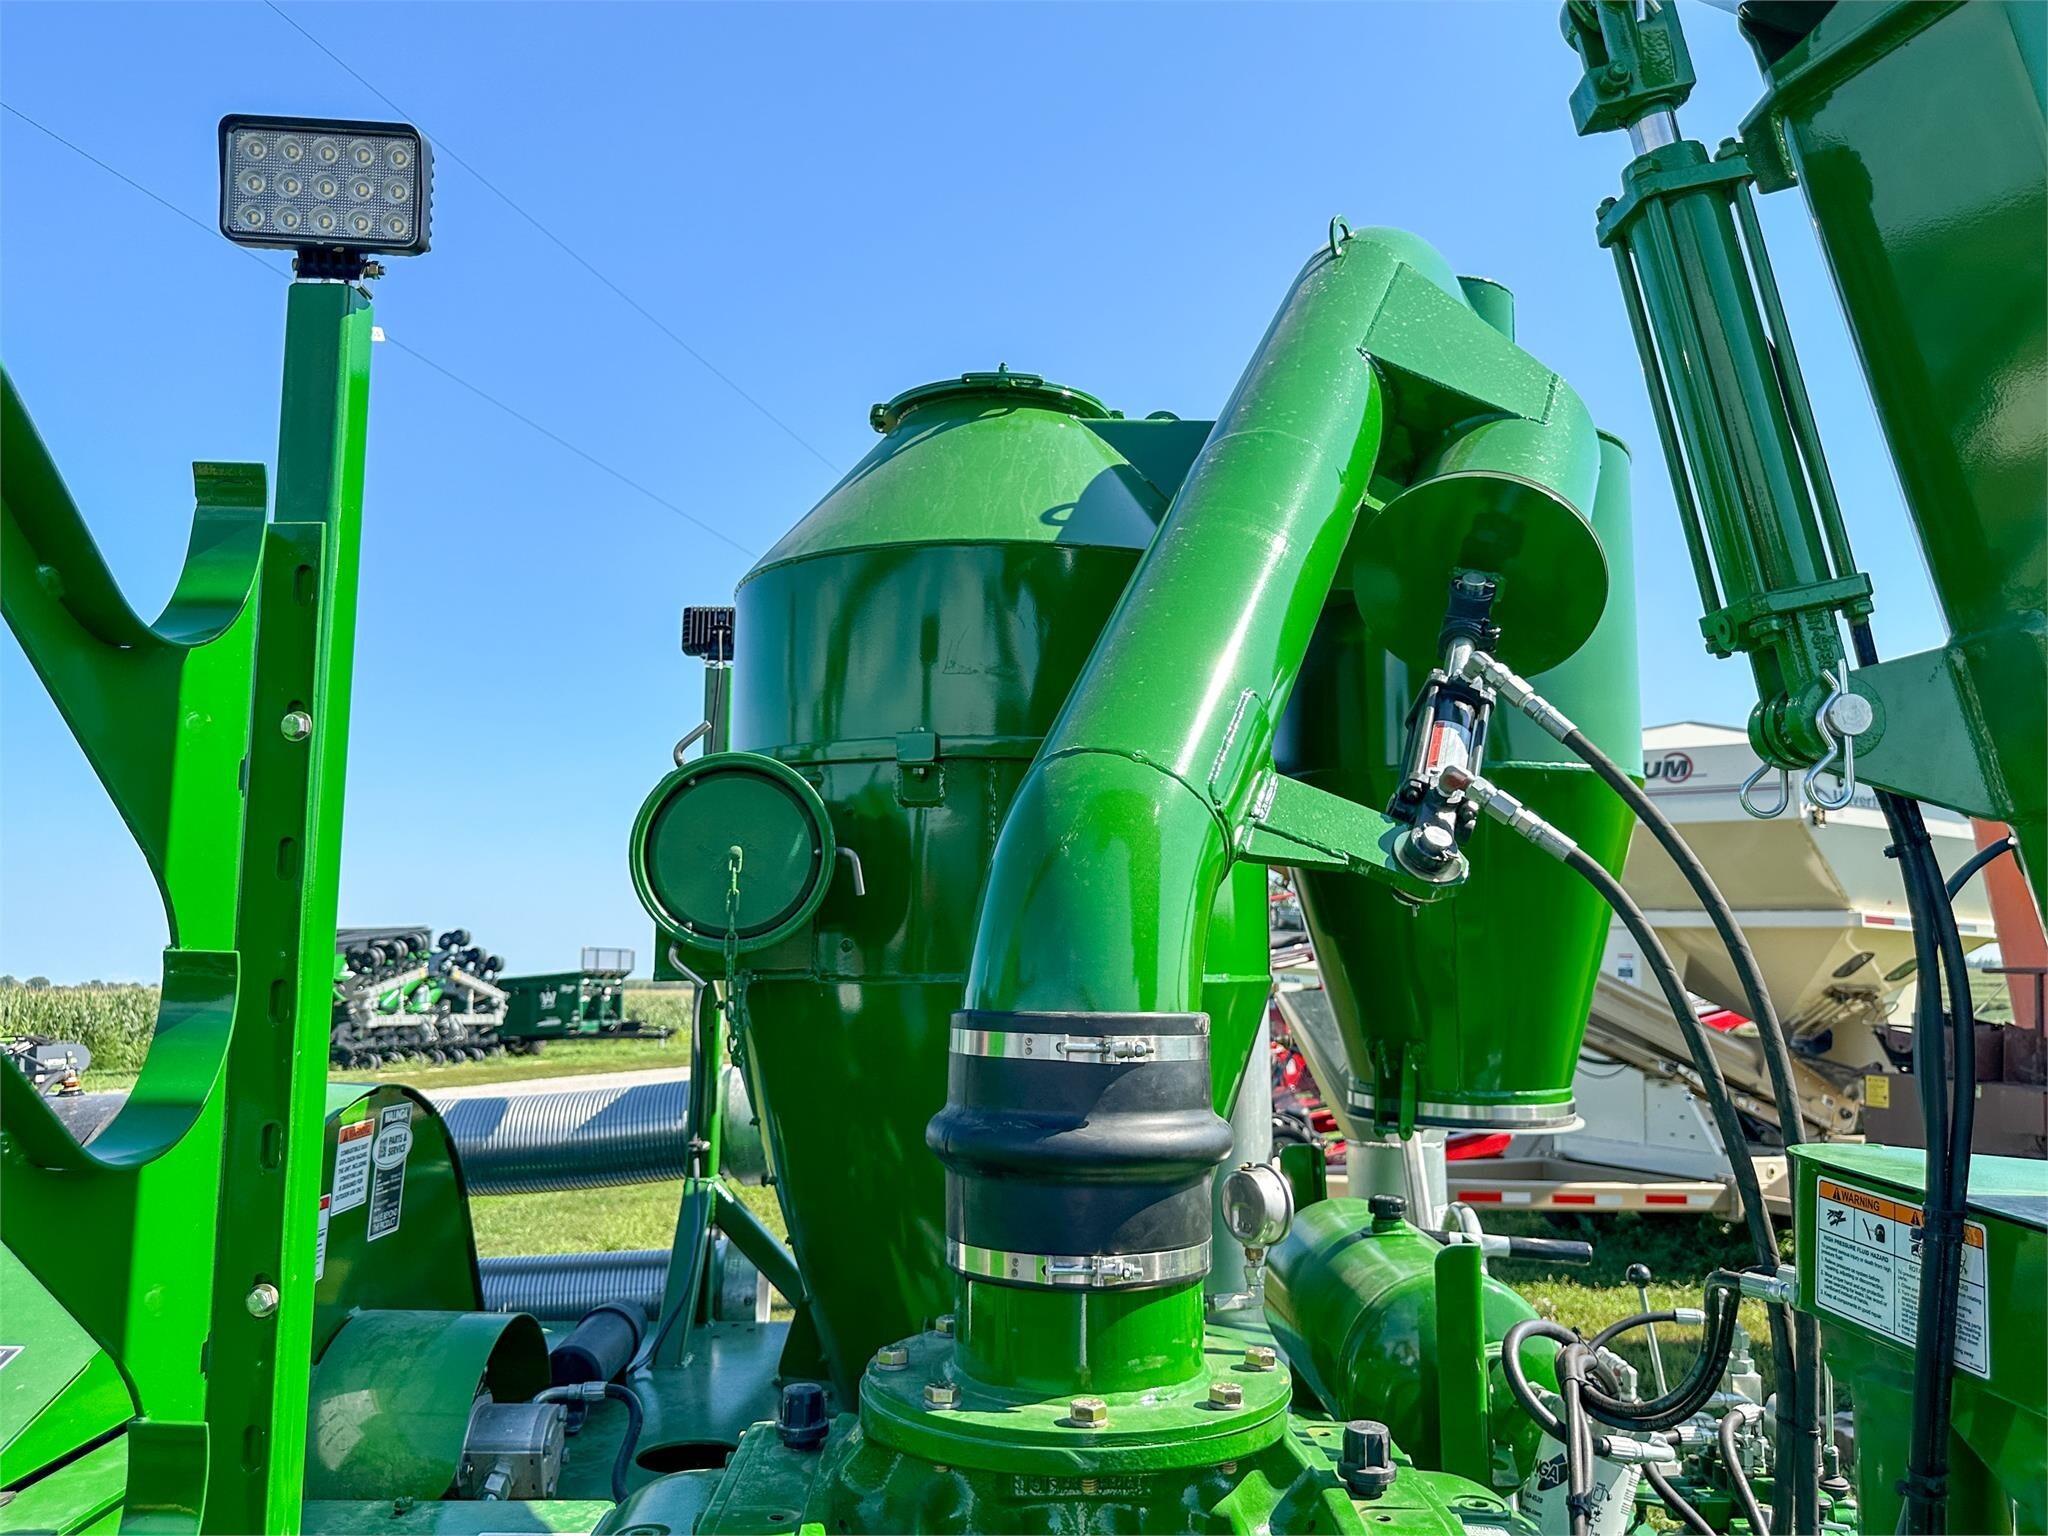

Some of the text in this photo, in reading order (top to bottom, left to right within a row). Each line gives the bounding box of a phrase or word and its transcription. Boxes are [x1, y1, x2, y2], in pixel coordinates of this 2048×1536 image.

[389, 1133, 403, 1145] PARTS
[388, 1144, 406, 1156] SERVICE
[1841, 1191, 1880, 1211] WARNING
[1824, 1235, 1888, 1263] HIGH PRESSURE FLUID HAZARD
